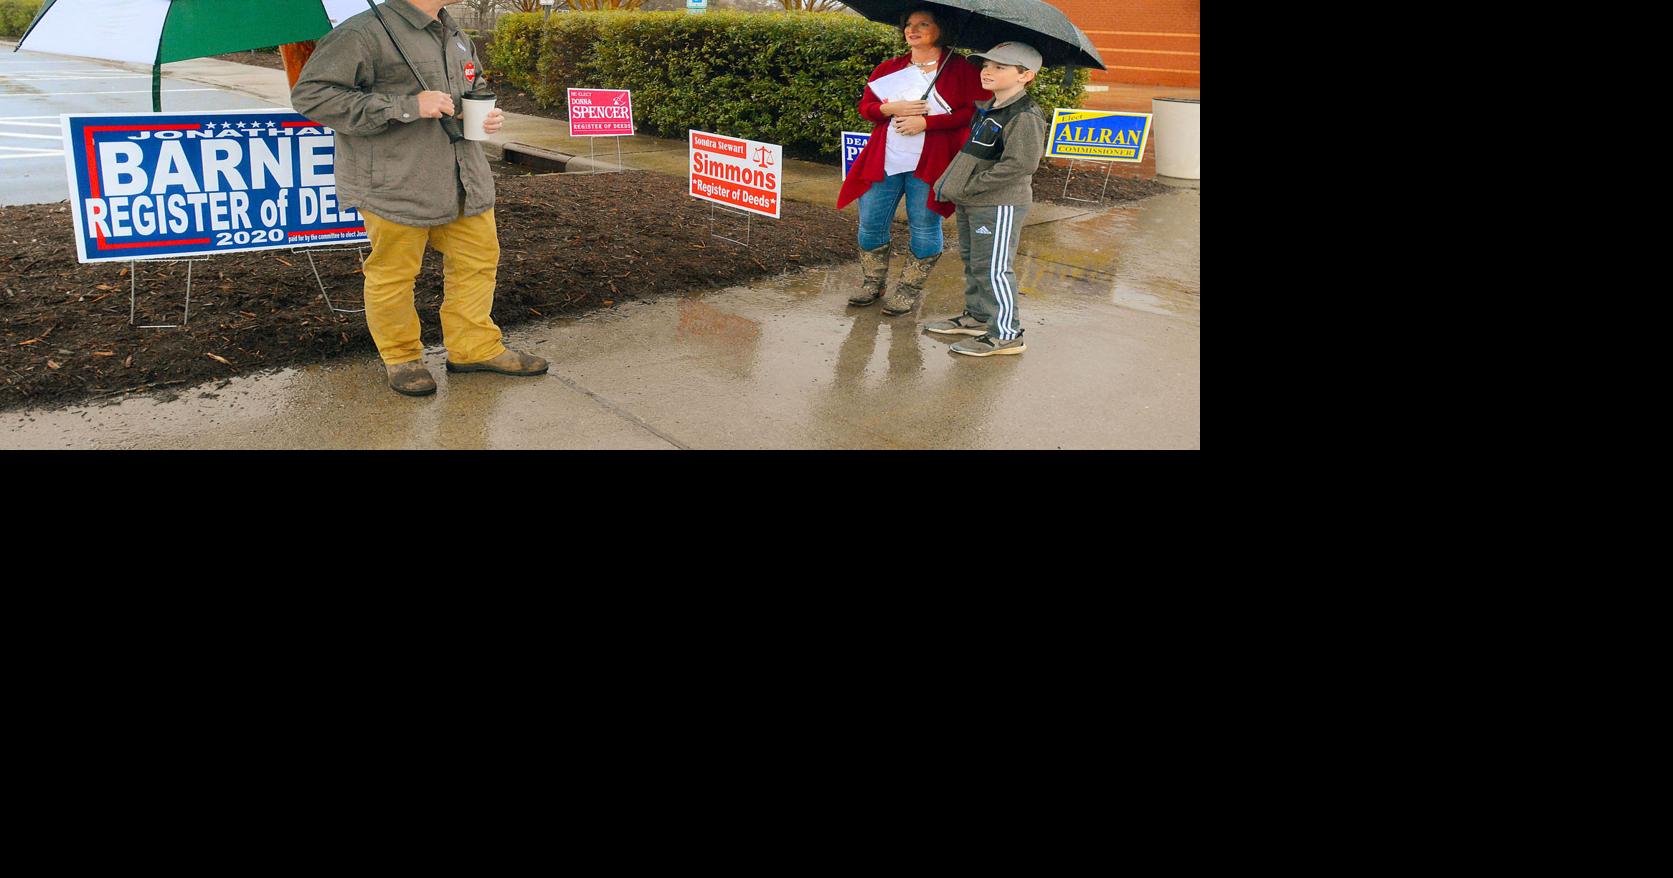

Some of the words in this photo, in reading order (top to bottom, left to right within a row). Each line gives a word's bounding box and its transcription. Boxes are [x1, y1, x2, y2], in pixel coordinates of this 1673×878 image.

[572, 105, 630, 119] SPENCER
[1061, 114, 1083, 122] Elect
[1057, 123, 1142, 146] ALLRAN
[694, 136, 717, 149] Sondra
[718, 141, 744, 154] Stewart
[1058, 146, 1133, 156] COMMISSIONER
[693, 152, 776, 190] Simmons
[697, 179, 731, 198] Register
[731, 189, 741, 201] of
[742, 190, 770, 208] Deeds
[85, 191, 252, 239] REGISTER
[260, 189, 288, 227] of
[299, 186, 364, 225] DE
[216, 229, 284, 246] 2020
[288, 235, 298, 244] paid
[305, 234, 310, 243] by
[318, 232, 340, 240] committee
